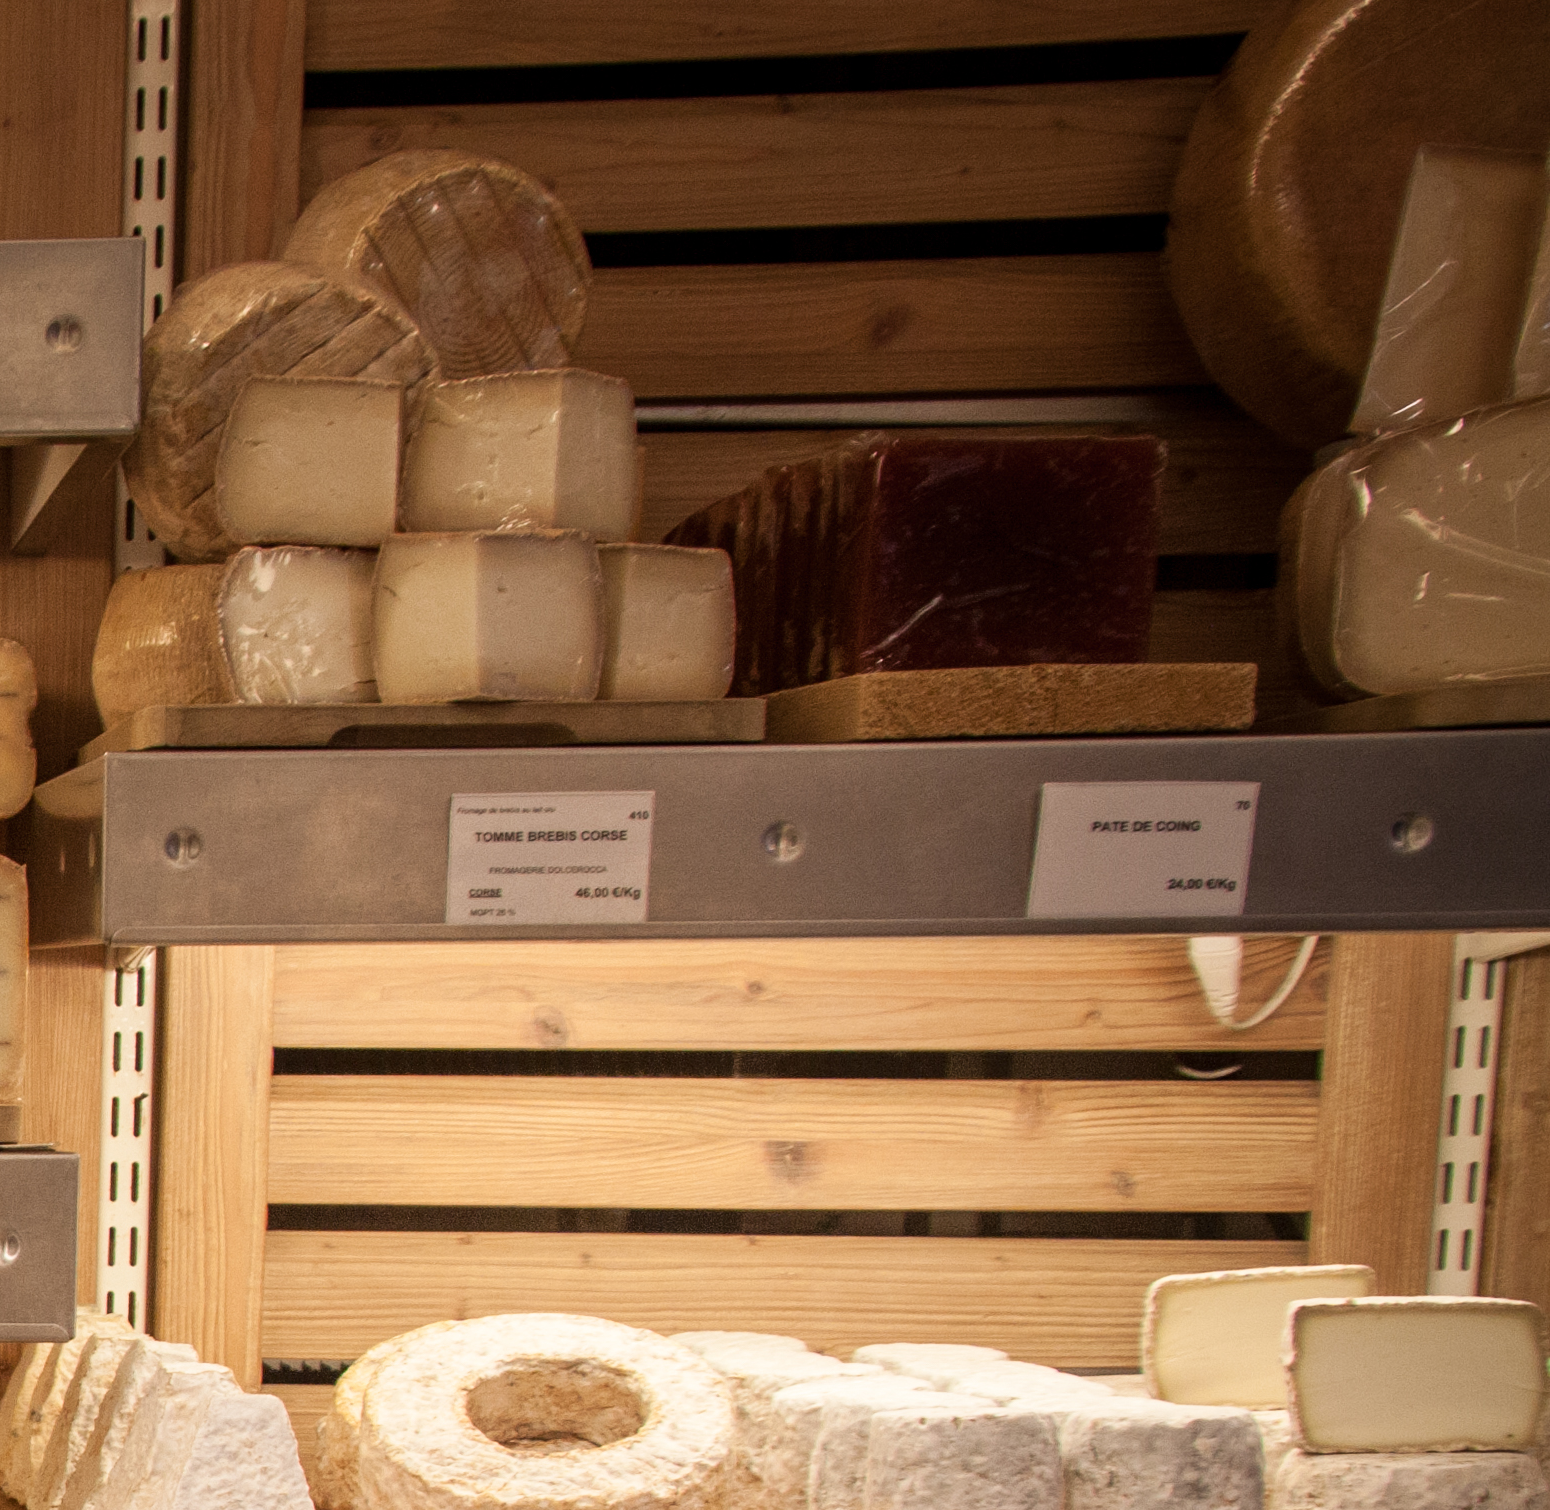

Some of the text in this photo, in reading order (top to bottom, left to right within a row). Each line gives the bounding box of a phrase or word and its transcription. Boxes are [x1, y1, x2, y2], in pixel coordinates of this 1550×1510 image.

[629, 811, 649, 819] 410
[1092, 821, 1201, 831] PATE DE COING
[476, 830, 627, 841] TOMME BREBIS CORSE
[612, 888, 640, 899] €/Kg
